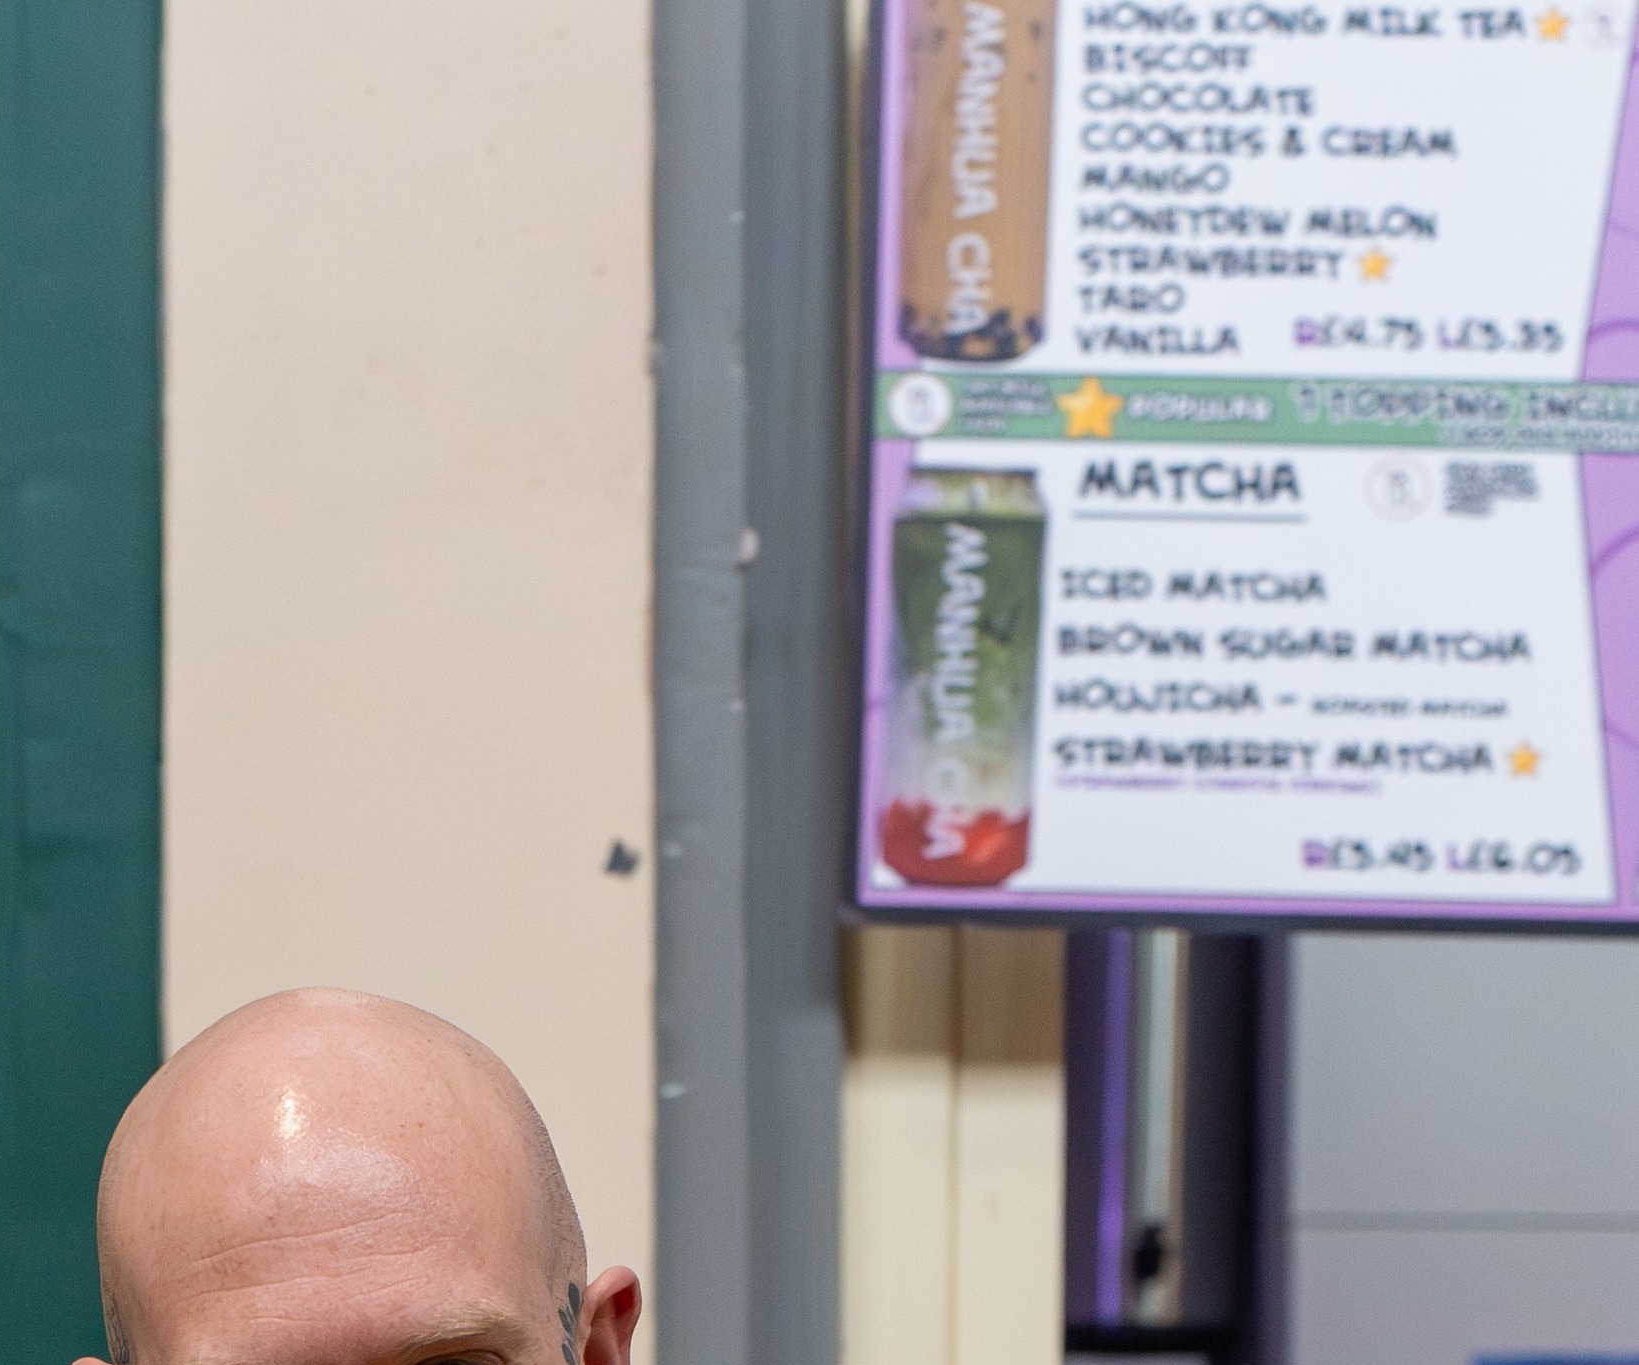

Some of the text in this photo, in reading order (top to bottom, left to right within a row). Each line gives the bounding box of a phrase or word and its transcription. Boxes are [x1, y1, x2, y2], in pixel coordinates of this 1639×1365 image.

[1084, 2, 1526, 40] HONG KONG MILK TEA
[1082, 43, 1254, 74] BISCOFF
[1081, 81, 1313, 115] CHOCOLATE
[1081, 122, 1458, 158] COOKIES & CREAM
[944, 2, 1007, 335] MANHUA CHA
[1082, 163, 1230, 193] MANGO
[1078, 203, 1437, 239] HONEYDEW MELON
[1077, 246, 1342, 278] STRAWBERRY
[1078, 284, 1185, 313] TARO
[1073, 324, 1240, 355] VANILLA
[1127, 393, 1274, 422] POPULAR
[1080, 461, 1300, 501] MATCHA
[1061, 570, 1326, 603] ICED MATCHA
[931, 522, 989, 745] MANHUA
[1057, 625, 1531, 663] BROWN SUGAR MATCHA
[1056, 736, 1493, 773] STRAWBERRY MATCHA
